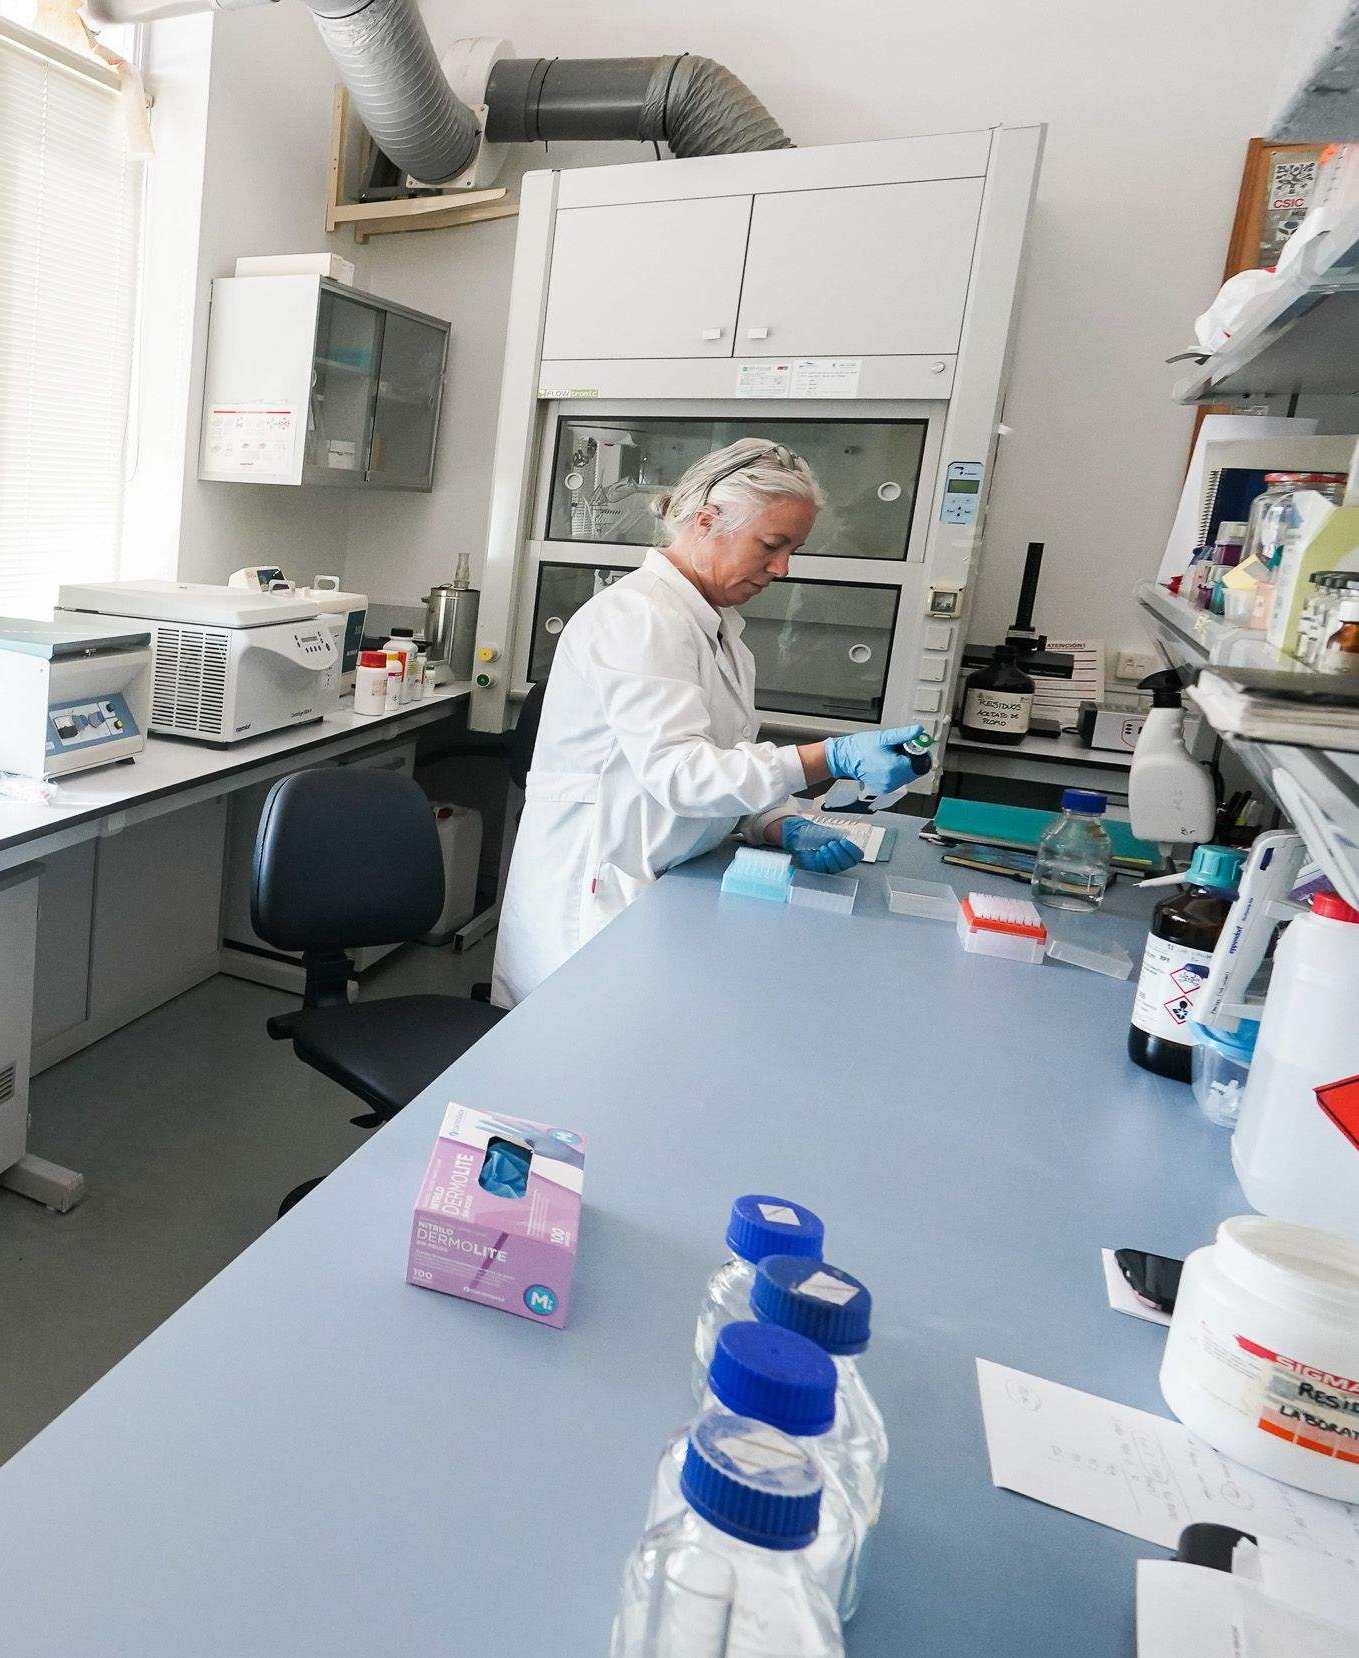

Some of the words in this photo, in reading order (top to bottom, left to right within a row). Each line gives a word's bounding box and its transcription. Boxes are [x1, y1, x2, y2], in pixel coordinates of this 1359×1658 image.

[1274, 198, 1304, 208] CSIC
[1230, 925, 1242, 955] eppendorf
[443, 1153, 474, 1216] DERMOLITE
[418, 1220, 454, 1236] NITRILO
[416, 1228, 507, 1262] DERMOLITE
[414, 1268, 433, 1280] 100
